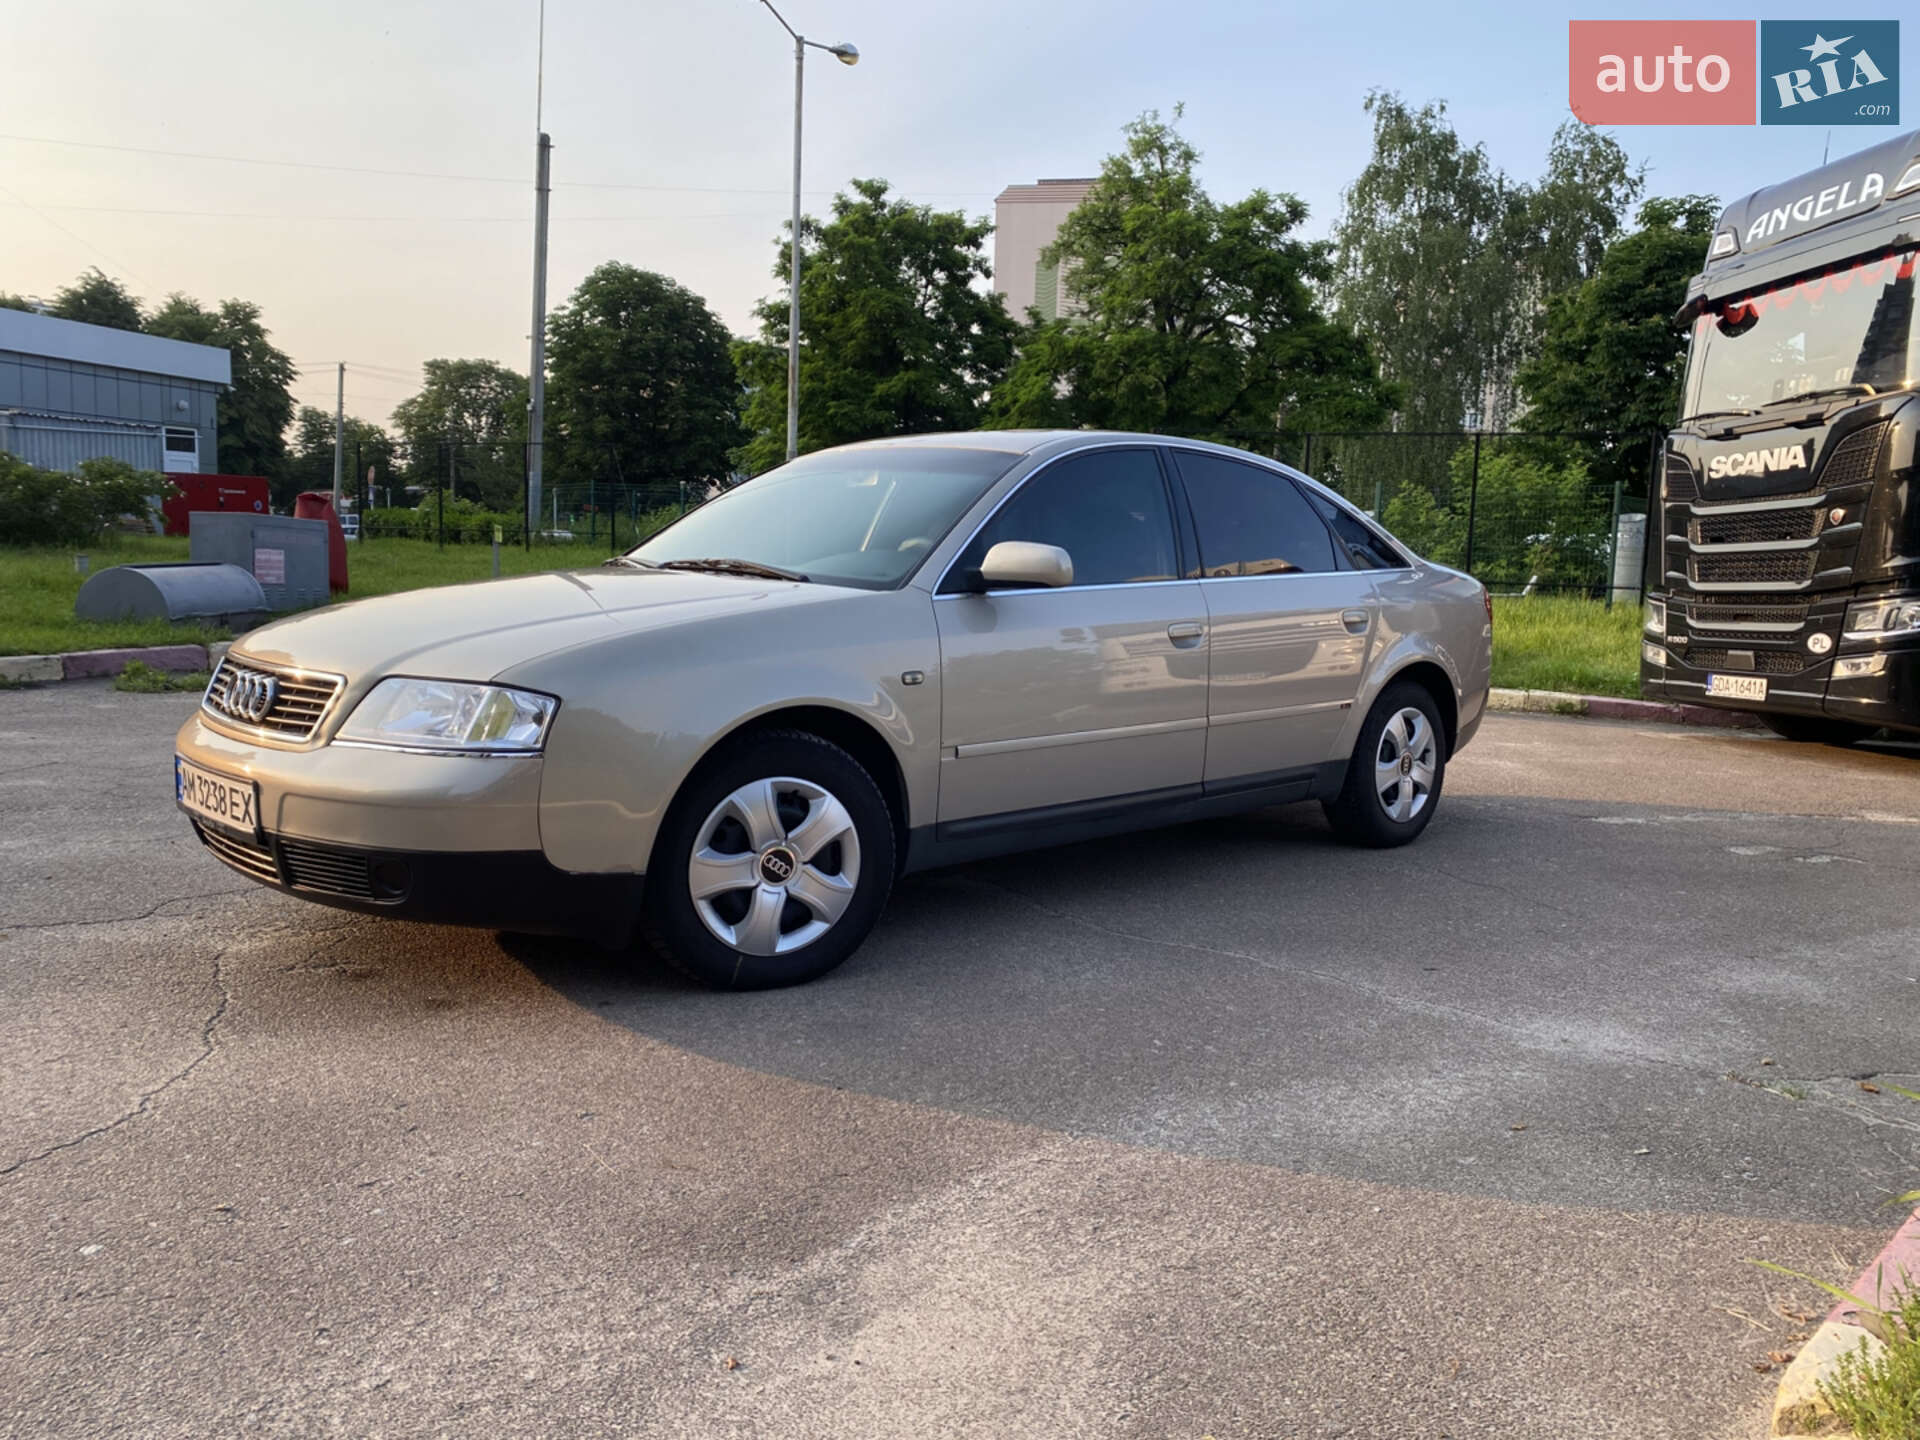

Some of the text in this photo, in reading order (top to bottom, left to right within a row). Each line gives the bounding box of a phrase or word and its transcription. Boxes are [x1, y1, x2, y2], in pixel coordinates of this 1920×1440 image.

[1745, 173, 1885, 244] ANGELA
[1709, 445, 1806, 479] SCANIA
[1812, 637, 1826, 649] PL
[229, 787, 253, 826] EX
